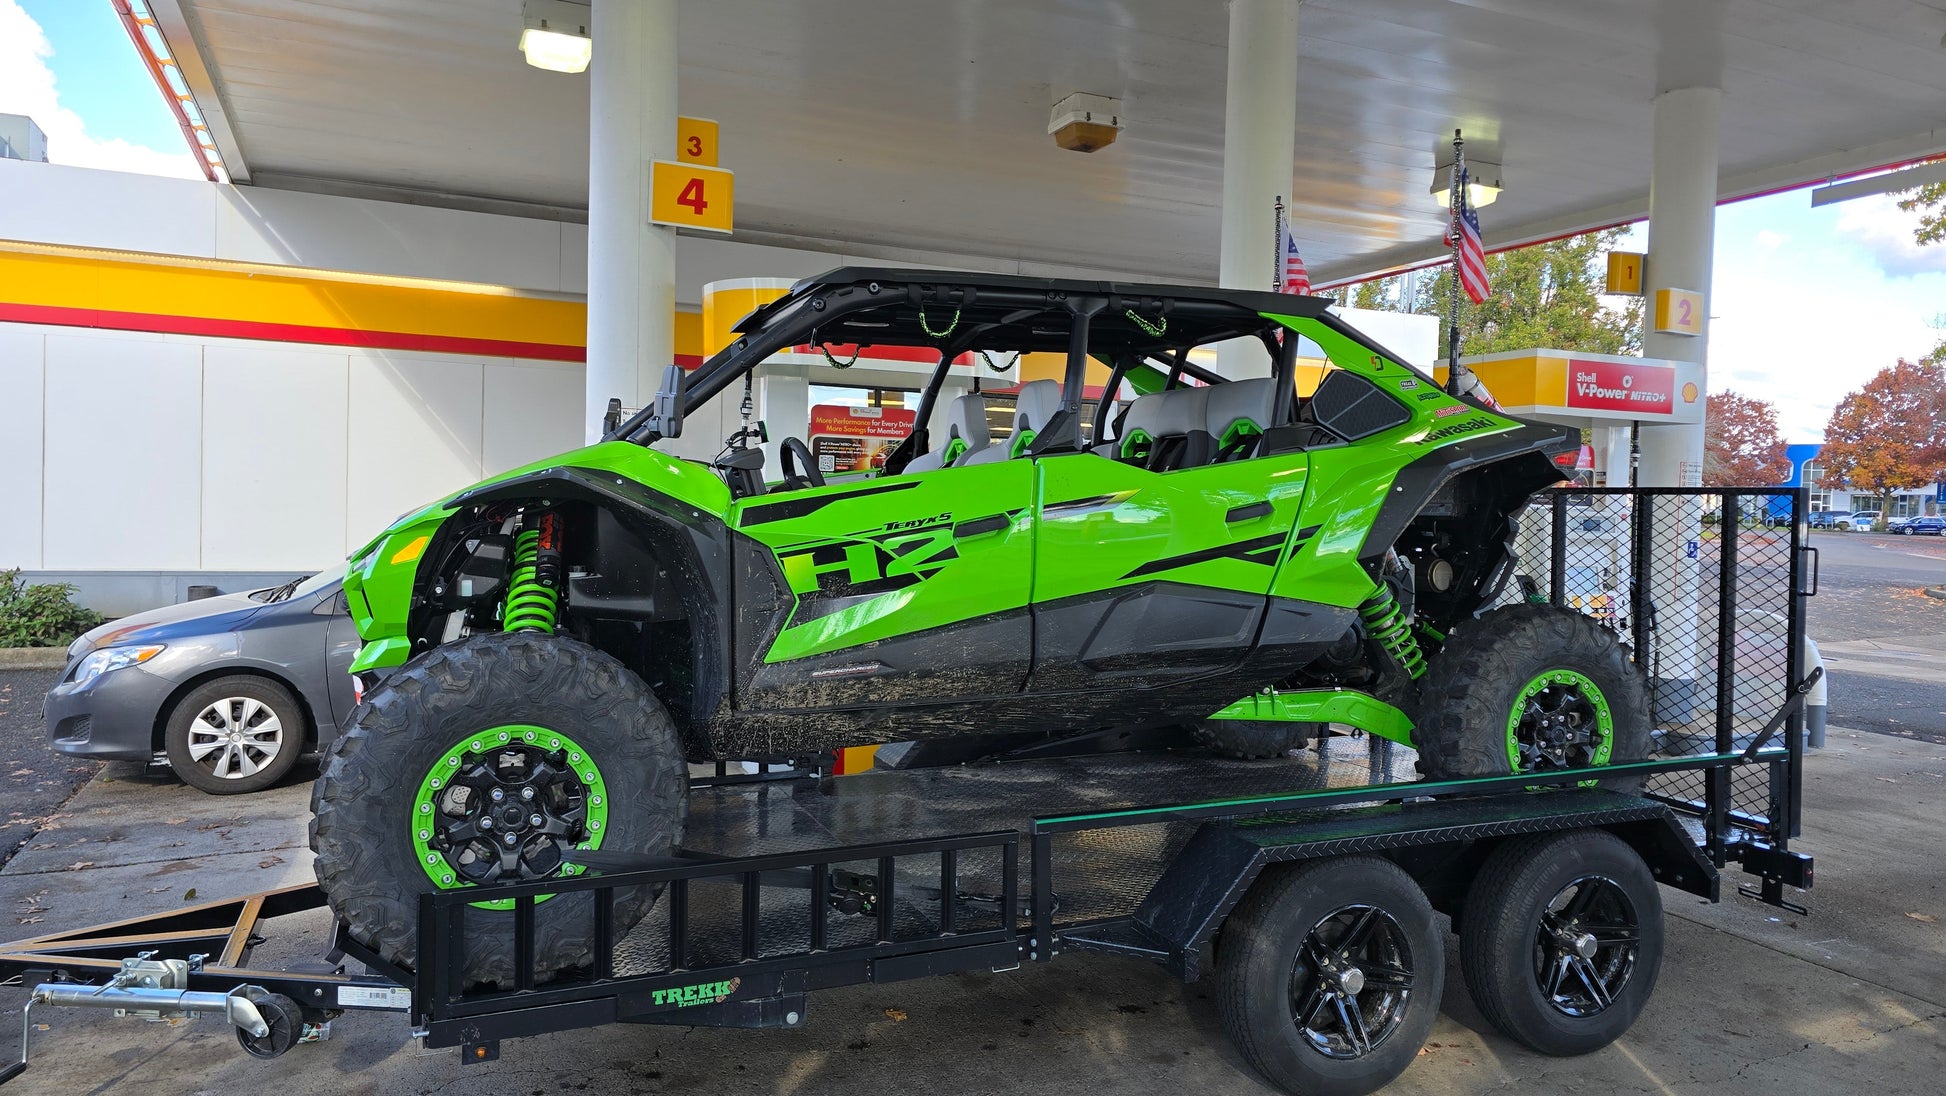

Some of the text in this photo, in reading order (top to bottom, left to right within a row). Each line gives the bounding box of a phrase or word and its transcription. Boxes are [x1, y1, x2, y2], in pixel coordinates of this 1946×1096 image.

[687, 136, 702, 156] 3
[677, 178, 707, 215] 4
[1627, 265, 1633, 280] 1
[1677, 298, 1692, 326] 2
[1576, 372, 1597, 383] Shell
[1576, 383, 1627, 400] V-Power
[833, 418, 870, 426] Performance
[882, 420, 898, 428] Every
[843, 426, 866, 434] Savings
[652, 981, 730, 1005] TREKK
[678, 998, 714, 1007] Trailers
